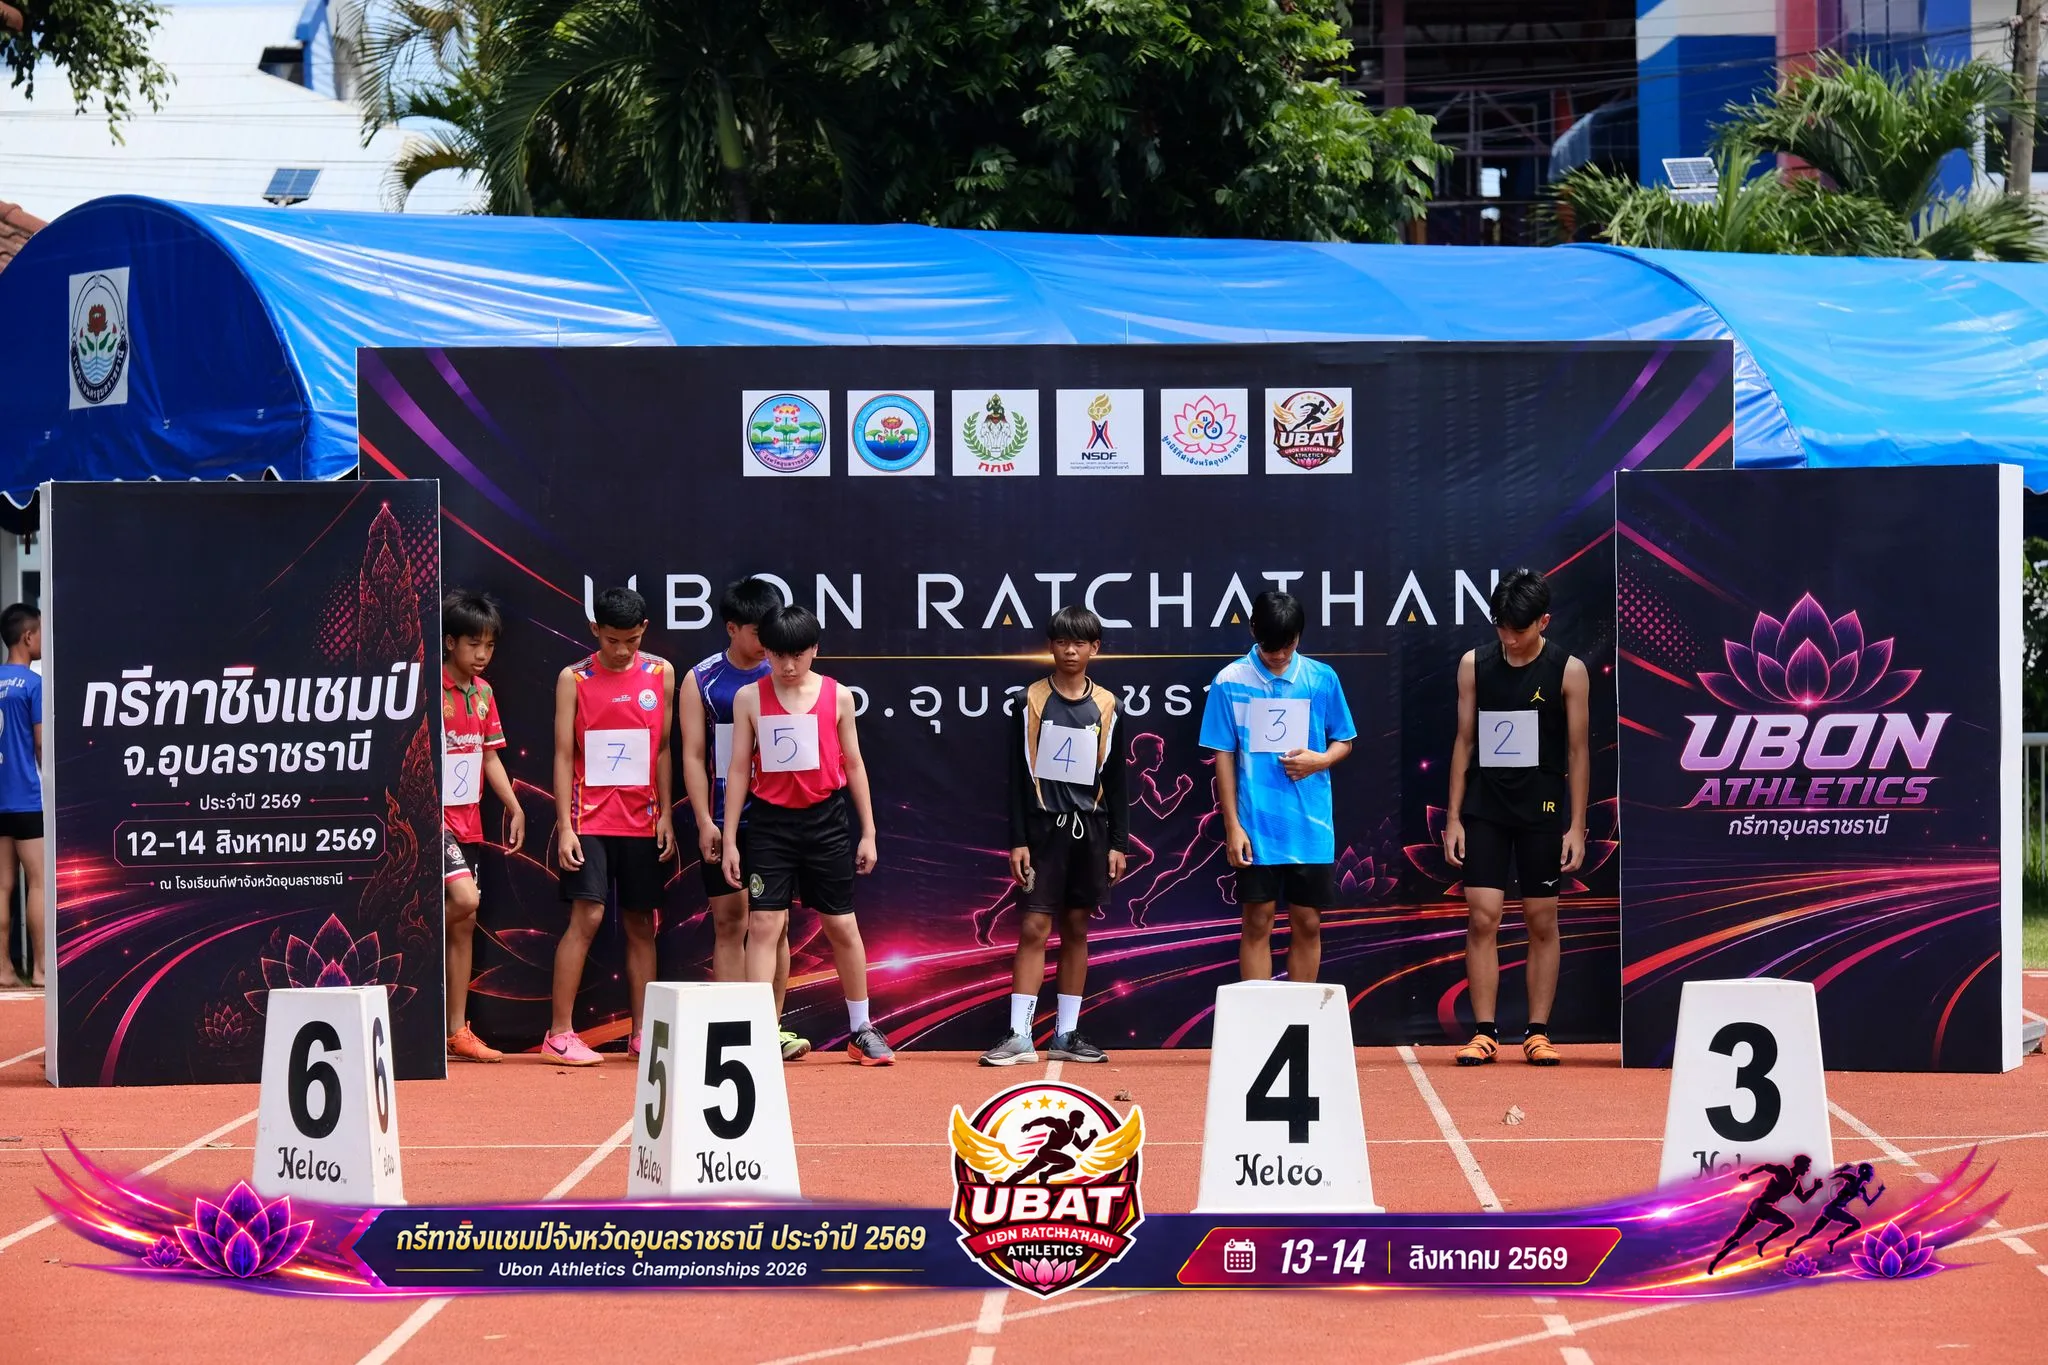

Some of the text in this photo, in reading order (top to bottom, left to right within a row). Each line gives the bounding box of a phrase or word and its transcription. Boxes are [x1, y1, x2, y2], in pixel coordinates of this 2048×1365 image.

[1081, 451, 1118, 461] NSDF
[1280, 431, 1339, 447] UBAT
[977, 461, 1015, 473] กกท
[82, 662, 421, 727] กรีฑาชิงแชมป์
[1265, 709, 1287, 742] 3
[1493, 720, 1521, 755] 2
[1680, 713, 1952, 771] UBON
[124, 729, 372, 788] จ.อุบลราชธานี
[607, 743, 632, 772] 7
[773, 727, 798, 764] 5
[1053, 736, 1077, 773] 4
[453, 760, 470, 798] 8
[1684, 776, 1942, 809] ATHLETICS
[200, 793, 302, 811] ประจำปี 2569
[1542, 801, 1555, 813] IR
[215, 829, 307, 855] สิงหาคม
[315, 828, 377, 852] 2569
[1728, 814, 1890, 840] กรีฑาอุบลราชธานี
[175, 872, 344, 892] โรงเรียนกีฬาจังหวัดอุบลราชธานี
[288, 1020, 342, 1139] 6
[372, 1016, 389, 1134] 6
[645, 1019, 670, 1140] 5
[703, 1020, 756, 1140] 5
[1246, 1024, 1320, 1144] 4
[1705, 1021, 1781, 1142] 3
[277, 1146, 341, 1183] Nelco
[636, 1145, 662, 1185] Nelco
[696, 1151, 762, 1184] Nelco
[1235, 1153, 1323, 1187] Nelco
